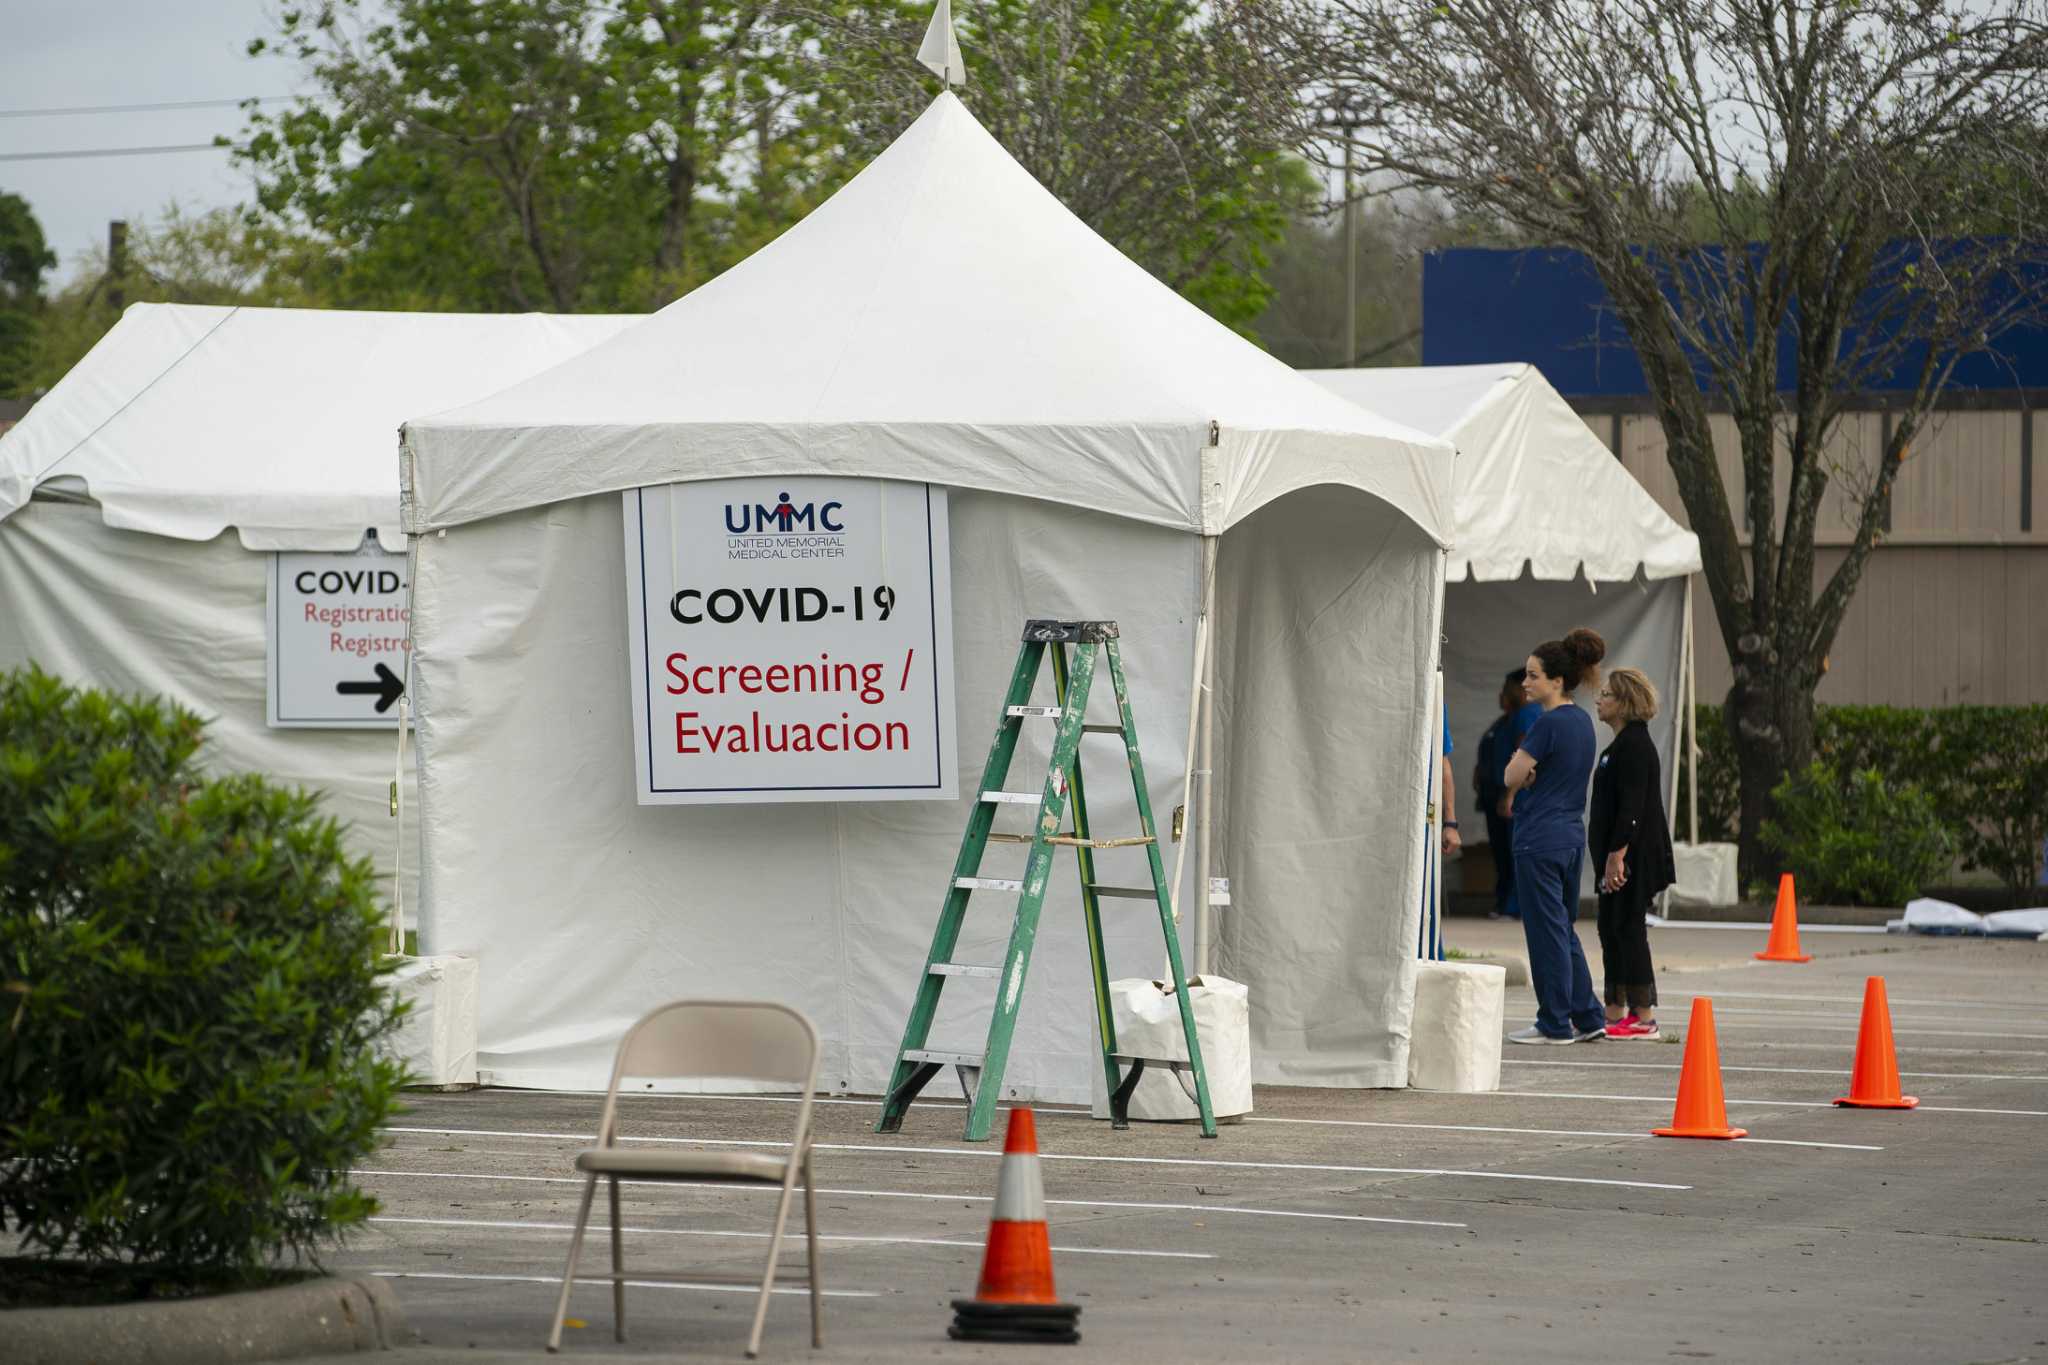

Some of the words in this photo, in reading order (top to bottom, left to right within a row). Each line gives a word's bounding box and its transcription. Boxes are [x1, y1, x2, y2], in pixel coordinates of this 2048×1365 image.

[725, 501, 845, 533] UMMC
[727, 538, 774, 549] UNITED
[776, 537, 845, 548] MEMORIAL
[728, 549, 787, 560] MEDICAL
[790, 548, 845, 559] CENTER
[669, 585, 896, 625] COVID-19
[666, 652, 885, 705] Screening
[899, 648, 914, 692] /
[675, 711, 910, 754] Evaluacion
